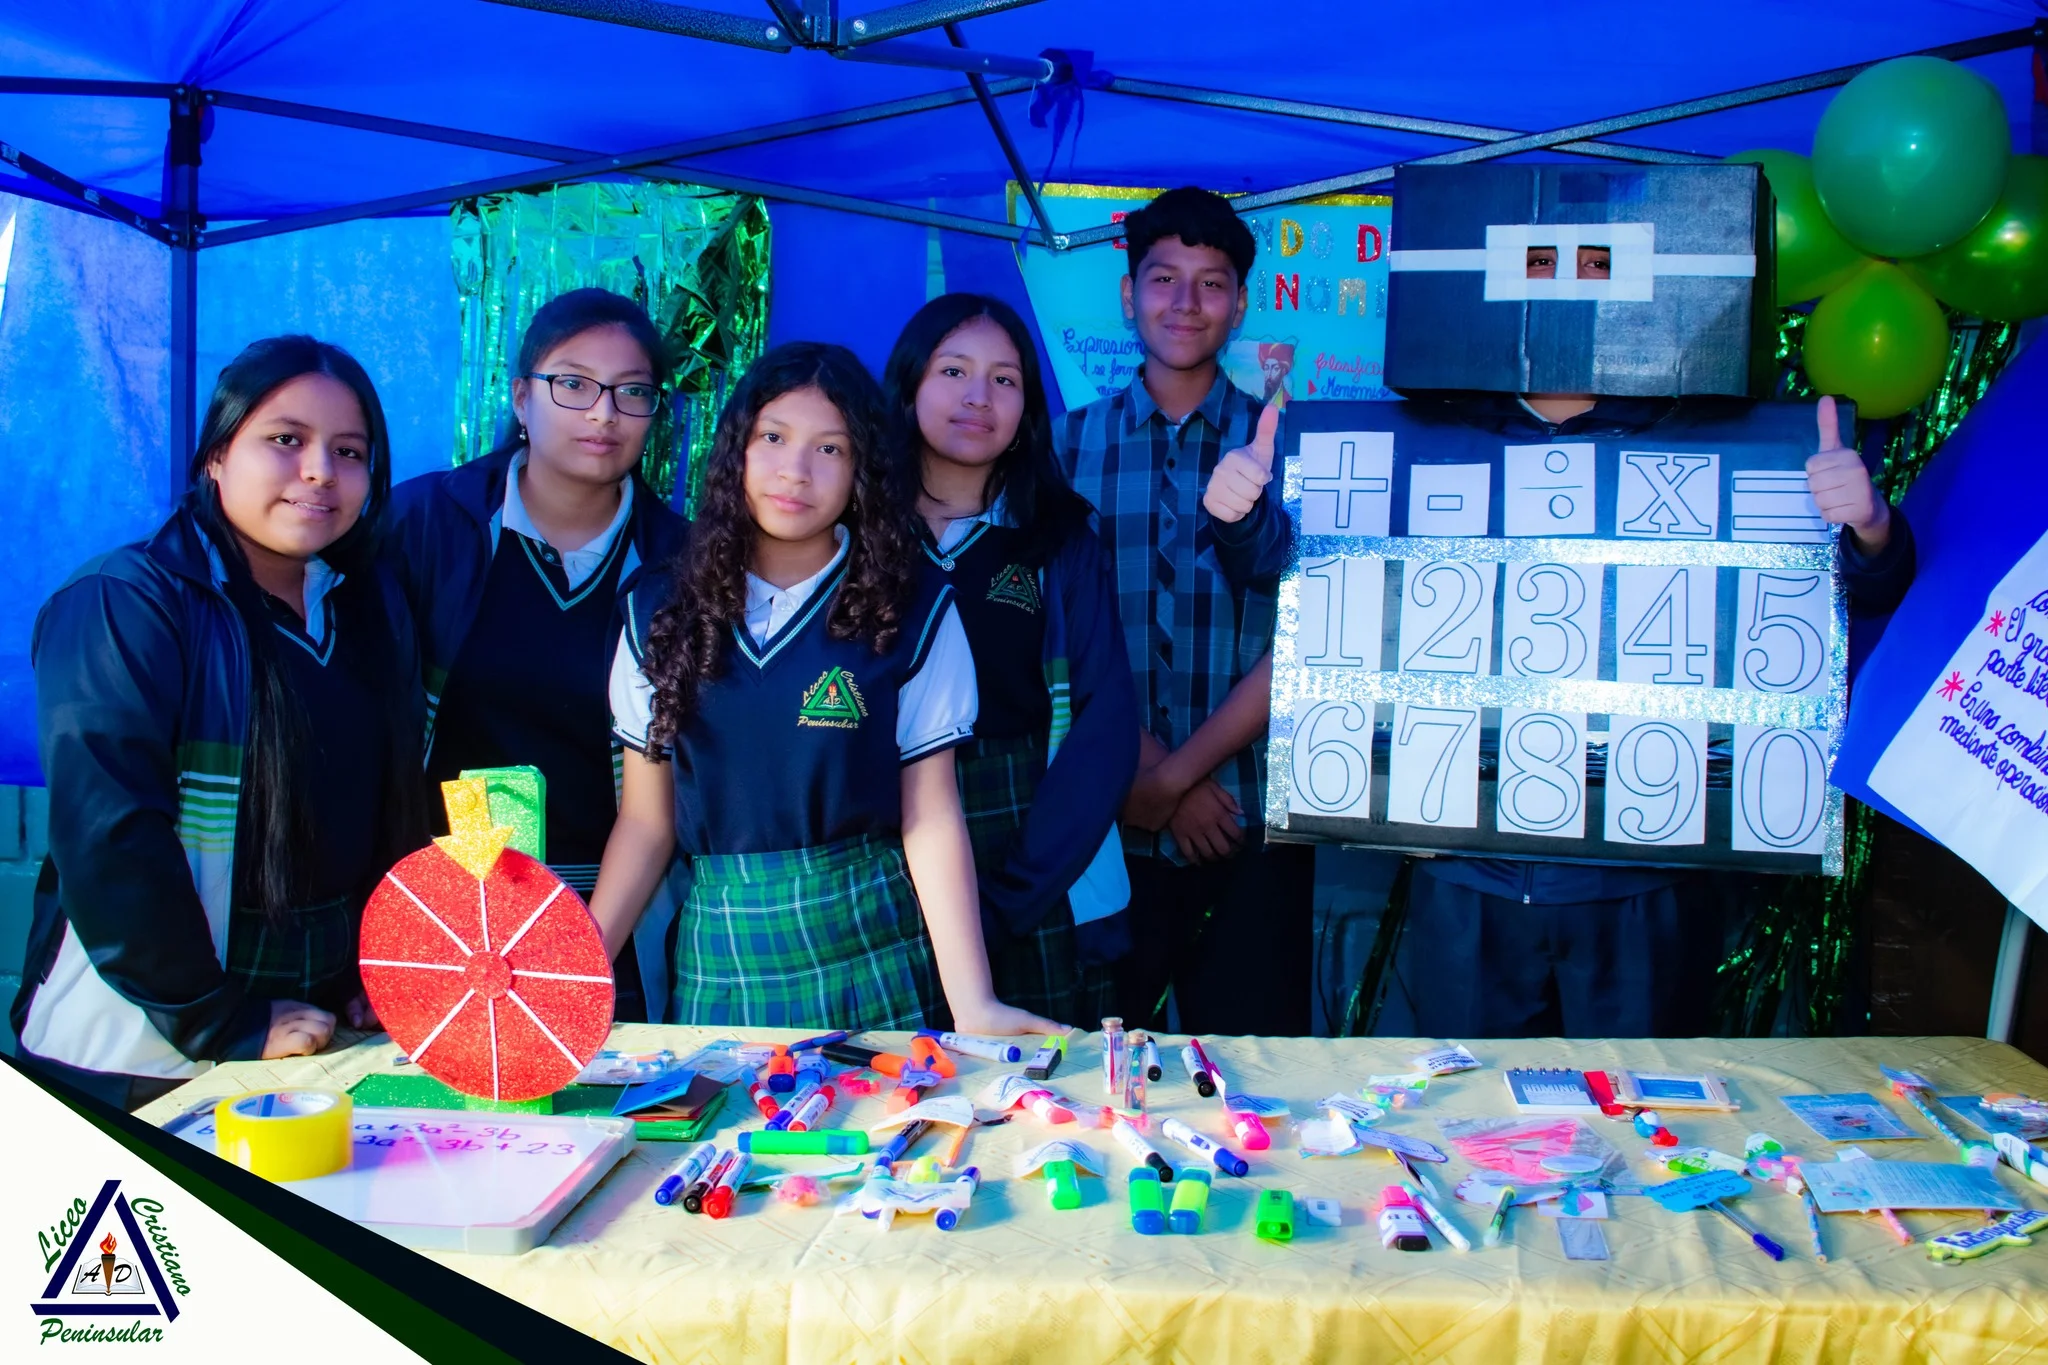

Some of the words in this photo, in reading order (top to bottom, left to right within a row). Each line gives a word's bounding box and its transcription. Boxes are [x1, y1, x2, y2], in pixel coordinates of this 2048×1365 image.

[1251, 216, 1334, 260] NDO
[1357, 224, 1391, 262] D
[1255, 270, 1387, 318] INOMI
[1314, 352, 1384, 384] Clasifica
[1304, 557, 1363, 667] 1
[1403, 560, 1484, 674] 2
[1508, 563, 1588, 680] 3
[1622, 568, 1708, 685] 4
[1743, 573, 1825, 694] 5
[2025, 589, 2048, 617] Co
[2014, 632, 2048, 671] gra
[803, 670, 828, 707] Liceo
[1976, 648, 2026, 689] parte
[2023, 665, 2048, 708] lite
[1939, 715, 2000, 770] mediante
[1292, 700, 1368, 813] 6
[1399, 706, 1477, 823] 7
[1498, 713, 1581, 832] 8
[1615, 721, 1699, 841] 9
[1740, 727, 1827, 848] 0
